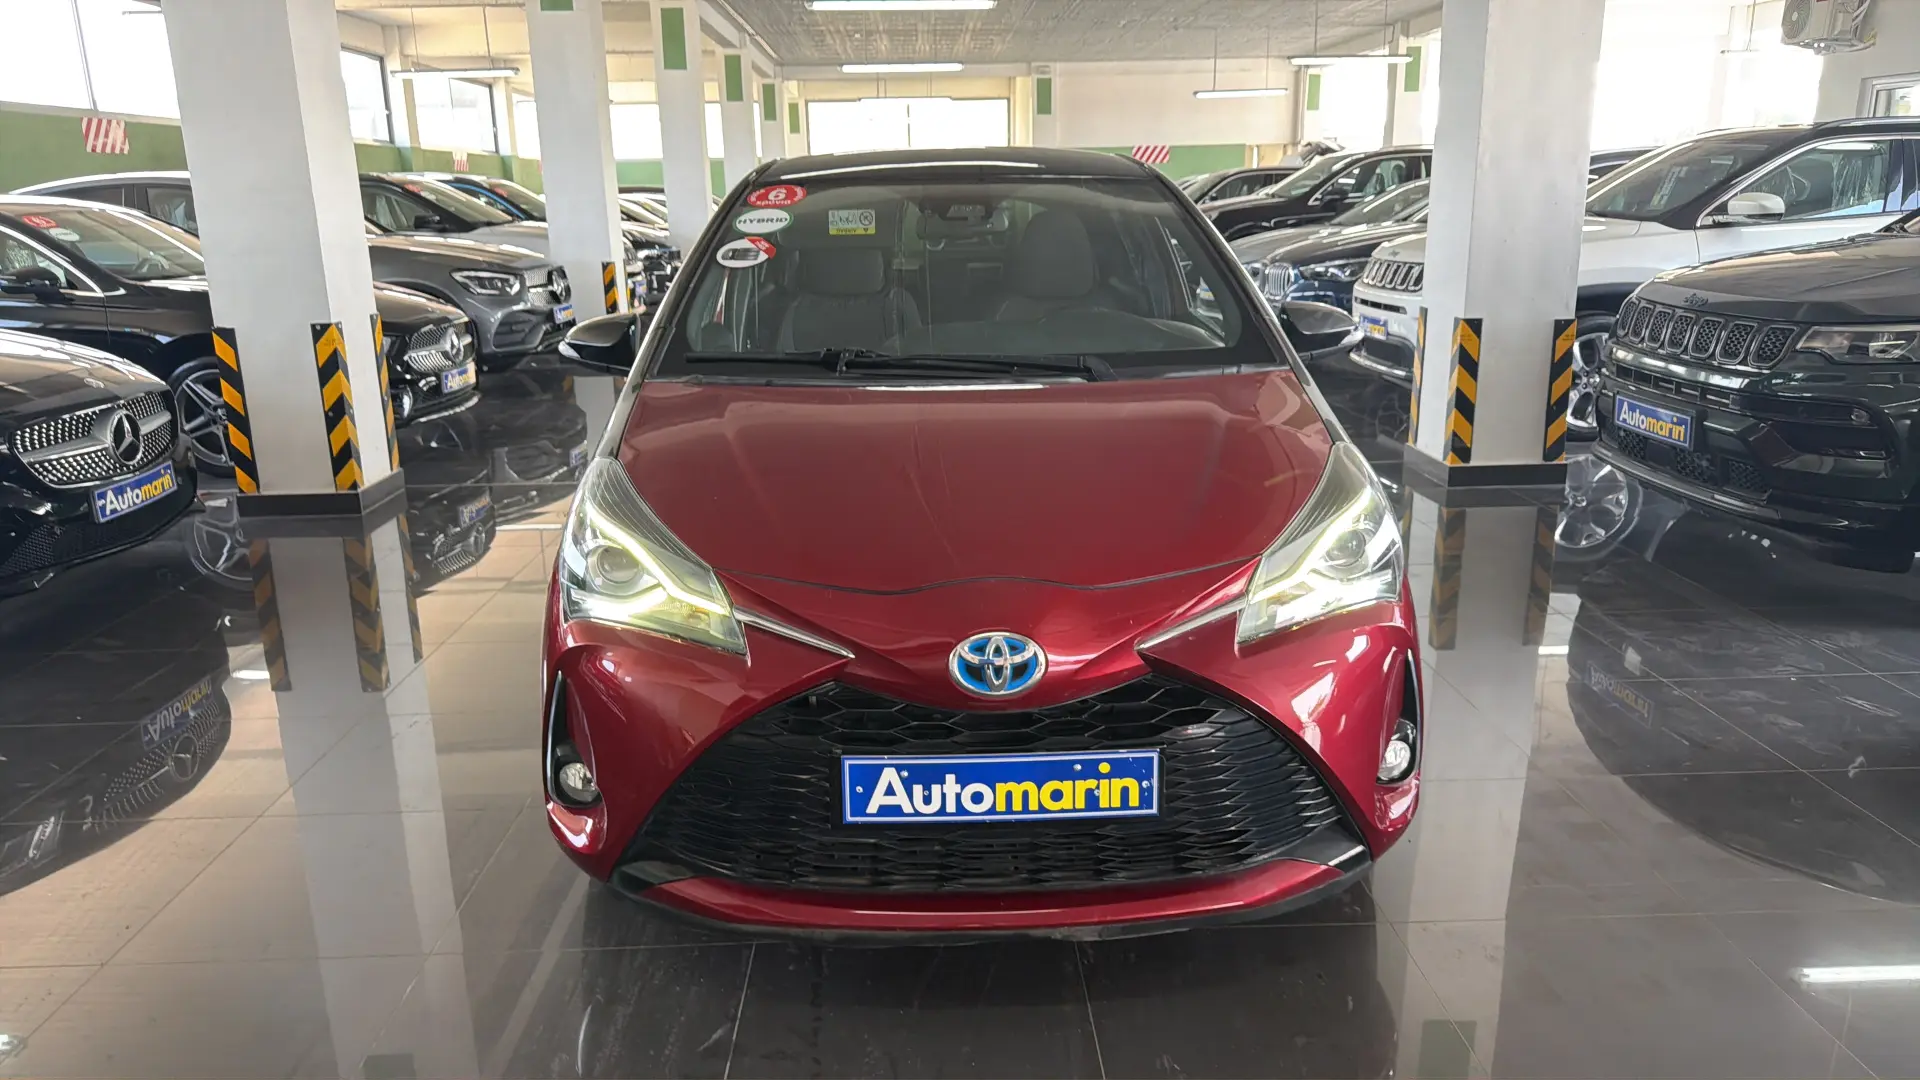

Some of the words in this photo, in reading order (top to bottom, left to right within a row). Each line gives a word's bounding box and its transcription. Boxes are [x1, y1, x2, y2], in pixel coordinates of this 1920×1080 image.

[768, 189, 788, 200] 6
[737, 217, 788, 225] HYBRID
[1619, 401, 1684, 441] Automarin
[106, 468, 173, 516] Automarin
[865, 761, 1140, 815] Automarin
